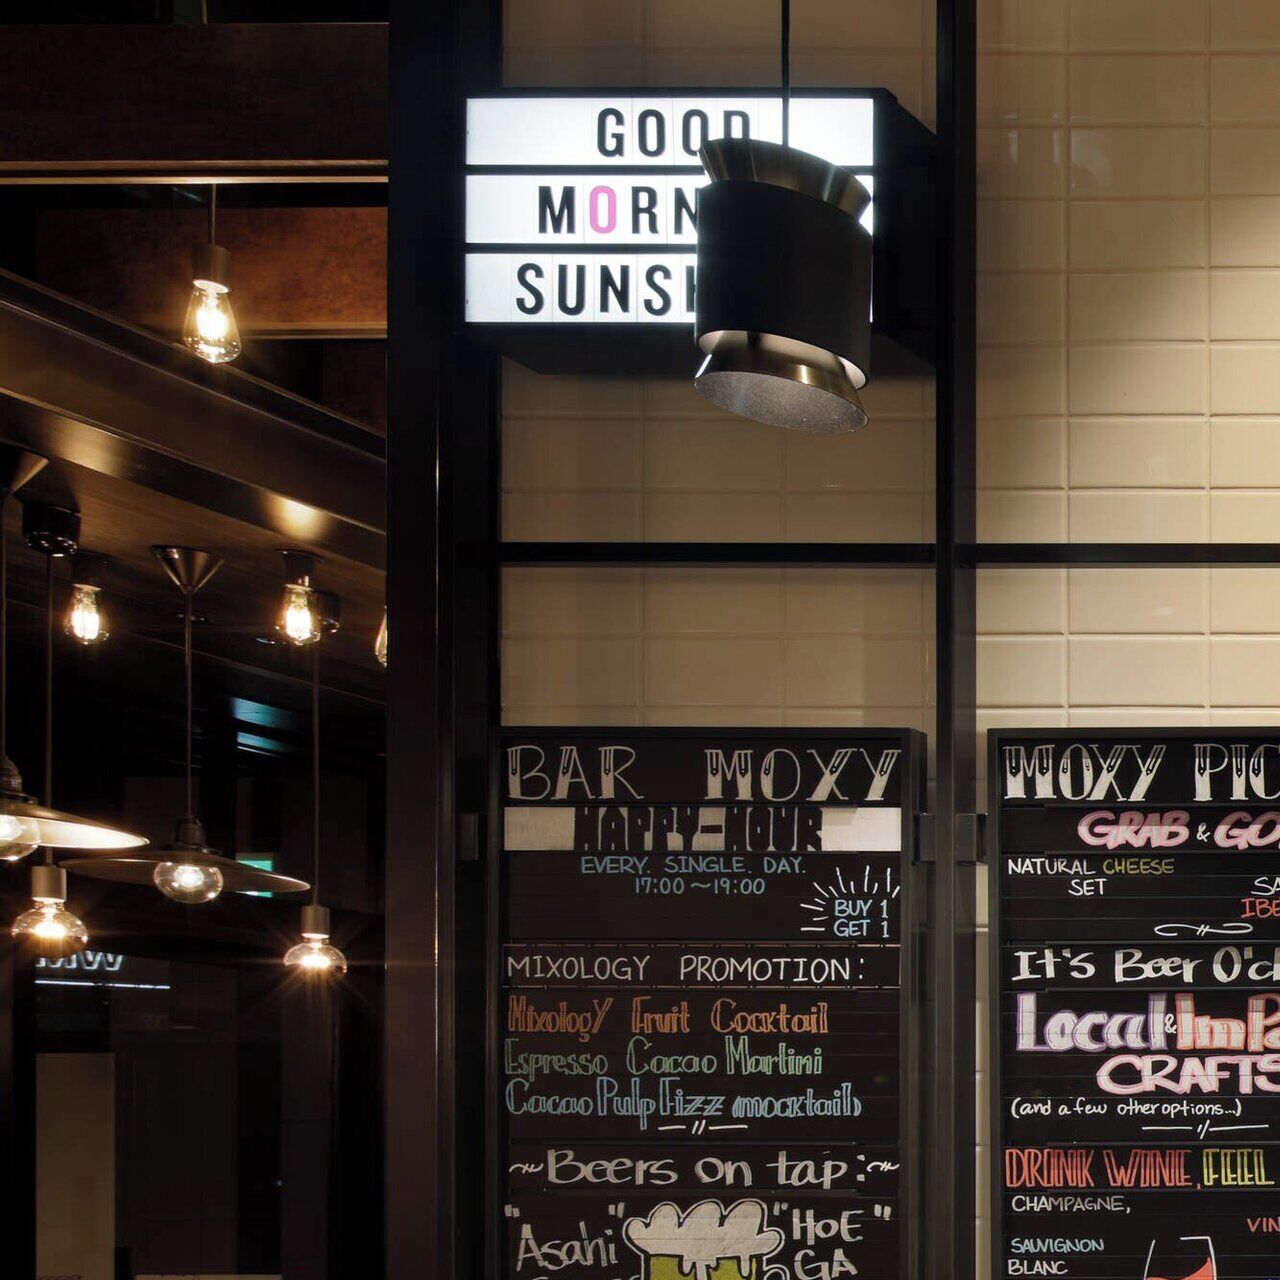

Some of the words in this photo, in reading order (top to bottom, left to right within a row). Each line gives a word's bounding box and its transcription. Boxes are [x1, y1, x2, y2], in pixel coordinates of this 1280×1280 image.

[538, 185, 698, 234] MORN
[516, 263, 697, 316] SUNS
[507, 745, 645, 800] BAR
[704, 748, 901, 801] MOXY
[1003, 744, 1167, 801] MOXY
[1077, 810, 1190, 850] GRAB
[1196, 823, 1210, 843] &
[1008, 858, 1096, 876] NATURAL
[1103, 858, 1175, 875] CHEESE
[1068, 878, 1107, 896] SET
[834, 900, 872, 917] BUY
[880, 900, 889, 918] 1
[833, 920, 870, 937] GET
[881, 920, 890, 938] 1
[507, 955, 650, 981] MIXOLOGY
[680, 955, 865, 982] PROMOTION:
[1011, 948, 1096, 981] It's
[1114, 948, 1205, 983] Beer
[631, 997, 690, 1033] Fruit
[711, 998, 829, 1033] Cocktail
[1016, 992, 1168, 1052] Local
[1164, 1013, 1177, 1034] &
[503, 1038, 608, 1081] Espresso
[625, 1036, 717, 1075] Cacao
[725, 1036, 822, 1075] Martini
[505, 1078, 593, 1116] Cacao
[597, 1077, 656, 1130] Pulp
[659, 1077, 726, 1116] Fizz
[1011, 1098, 1052, 1119] (and
[1072, 1097, 1107, 1114] few
[1117, 1098, 1155, 1115] other
[547, 1149, 678, 1187] Beers
[694, 1157, 752, 1187] on
[1005, 1149, 1094, 1188] DRINK
[1203, 1148, 1275, 1187] FEEL
[1011, 1195, 1131, 1213] CHAMPAGNE,
[793, 1249, 857, 1280] GA
[1008, 1258, 1069, 1276] BLANC
